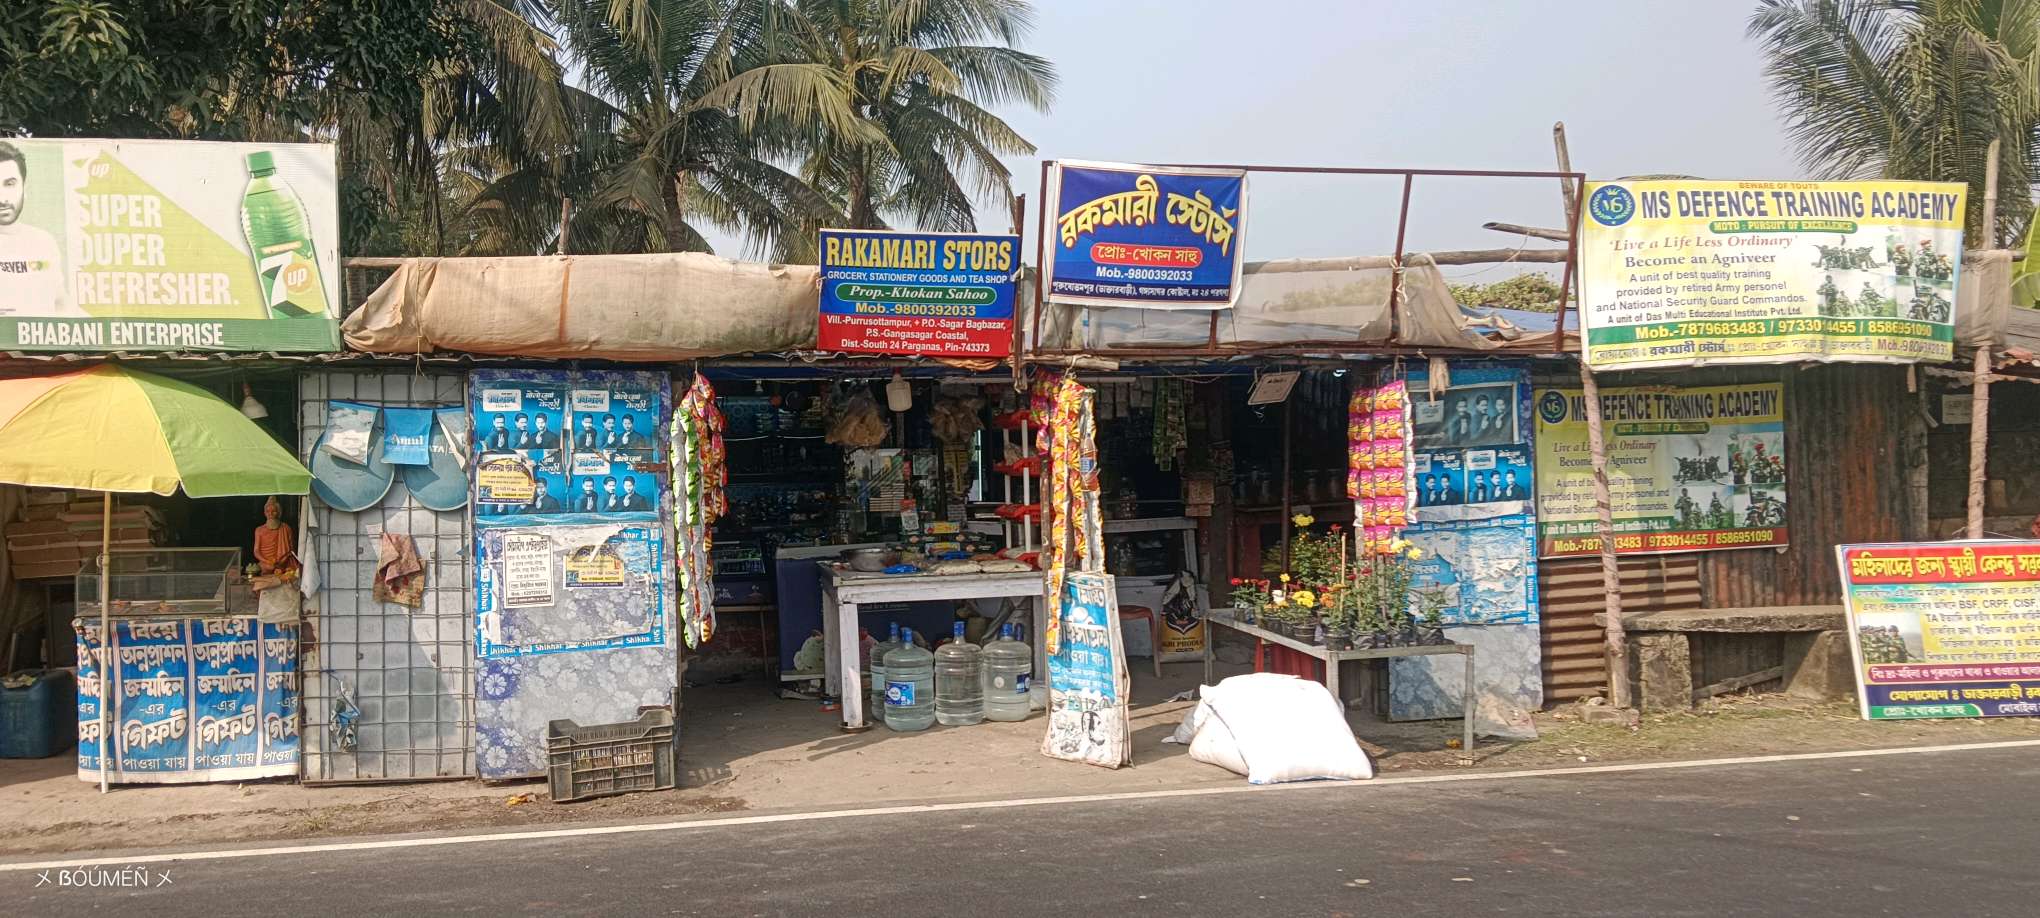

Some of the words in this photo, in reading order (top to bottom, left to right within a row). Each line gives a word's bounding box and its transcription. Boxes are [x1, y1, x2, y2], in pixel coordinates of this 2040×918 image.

[79, 194, 162, 227] SUPER
[1058, 174, 1159, 249] রকমারী
[1642, 191, 1670, 219] MS
[1677, 190, 1768, 218] DEFENCE
[1771, 190, 1864, 218] TRAINING
[1871, 191, 1958, 221] ACADEMY
[81, 233, 166, 266] DUPER
[1649, 240, 1658, 249] a
[1664, 237, 1692, 249] Life
[1696, 236, 1723, 247] Less
[826, 237, 937, 269] RAKAMARI
[943, 240, 1012, 271] STORS
[1176, 249, 1198, 264] সাহু
[0, 261, 28, 274] SEVEN
[1625, 256, 1685, 268] Become
[1691, 256, 1707, 264] an
[1712, 254, 1776, 271] Agniveer
[827, 271, 867, 281] GROCERY,
[869, 272, 918, 282] STATIONERY
[919, 274, 948, 283] GOODS
[950, 274, 966, 283] AND
[969, 275, 984, 284] TEA
[985, 275, 1007, 284] SHOP
[1096, 266, 1193, 281] Mob.-9800392033
[1630, 274, 1638, 283] A
[1640, 273, 1660, 282] unit
[1663, 271, 1673, 281] of
[1677, 271, 1697, 279] best
[1700, 271, 1731, 281] quality
[1734, 269, 1771, 280] training
[78, 272, 240, 305] REFRESHER.
[849, 286, 943, 300] Prop.-Khokan
[946, 287, 988, 300] Sahoo
[1616, 285, 1662, 299] provided
[1666, 285, 1678, 295] by
[1682, 283, 1713, 293] retired
[1715, 284, 1740, 294] Army
[855, 302, 976, 316] Mob.-9800392033
[1596, 303, 1616, 312] and
[1620, 301, 1662, 311] National
[1667, 298, 1707, 310] Security
[1710, 296, 1739, 306] Guard
[1608, 316, 1613, 324] A
[1616, 314, 1632, 323] unit
[1635, 314, 1643, 322] of
[1646, 312, 1662, 321] Das
[1665, 311, 1686, 320] Multi
[1689, 309, 1732, 318] Educational
[1735, 308, 1767, 317] Institute
[18, 322, 103, 345] BHABANI
[111, 323, 224, 346] ENTERPRISE
[936, 331, 968, 341] Coastal,
[1635, 321, 1766, 339] Mob.-7879683483
[890, 341, 899, 349] 24
[902, 341, 943, 352] Parganas,
[945, 343, 990, 352] Pin-743373
[1602, 393, 1651, 421] EFENCE
[1718, 389, 1779, 418] ACADEMY
[1610, 455, 1647, 468] Agniveer
[1649, 533, 1708, 547] 9733014455
[1716, 530, 1773, 545] 8586951090
[1851, 552, 1913, 578] মহিলাদের
[1916, 556, 1946, 577] জন্য
[1948, 547, 1976, 578] স্থায়ী
[1980, 554, 2016, 576] কেন্দ্র
[124, 670, 185, 698] জন্মদিন
[197, 668, 256, 694] জন্মদিন
